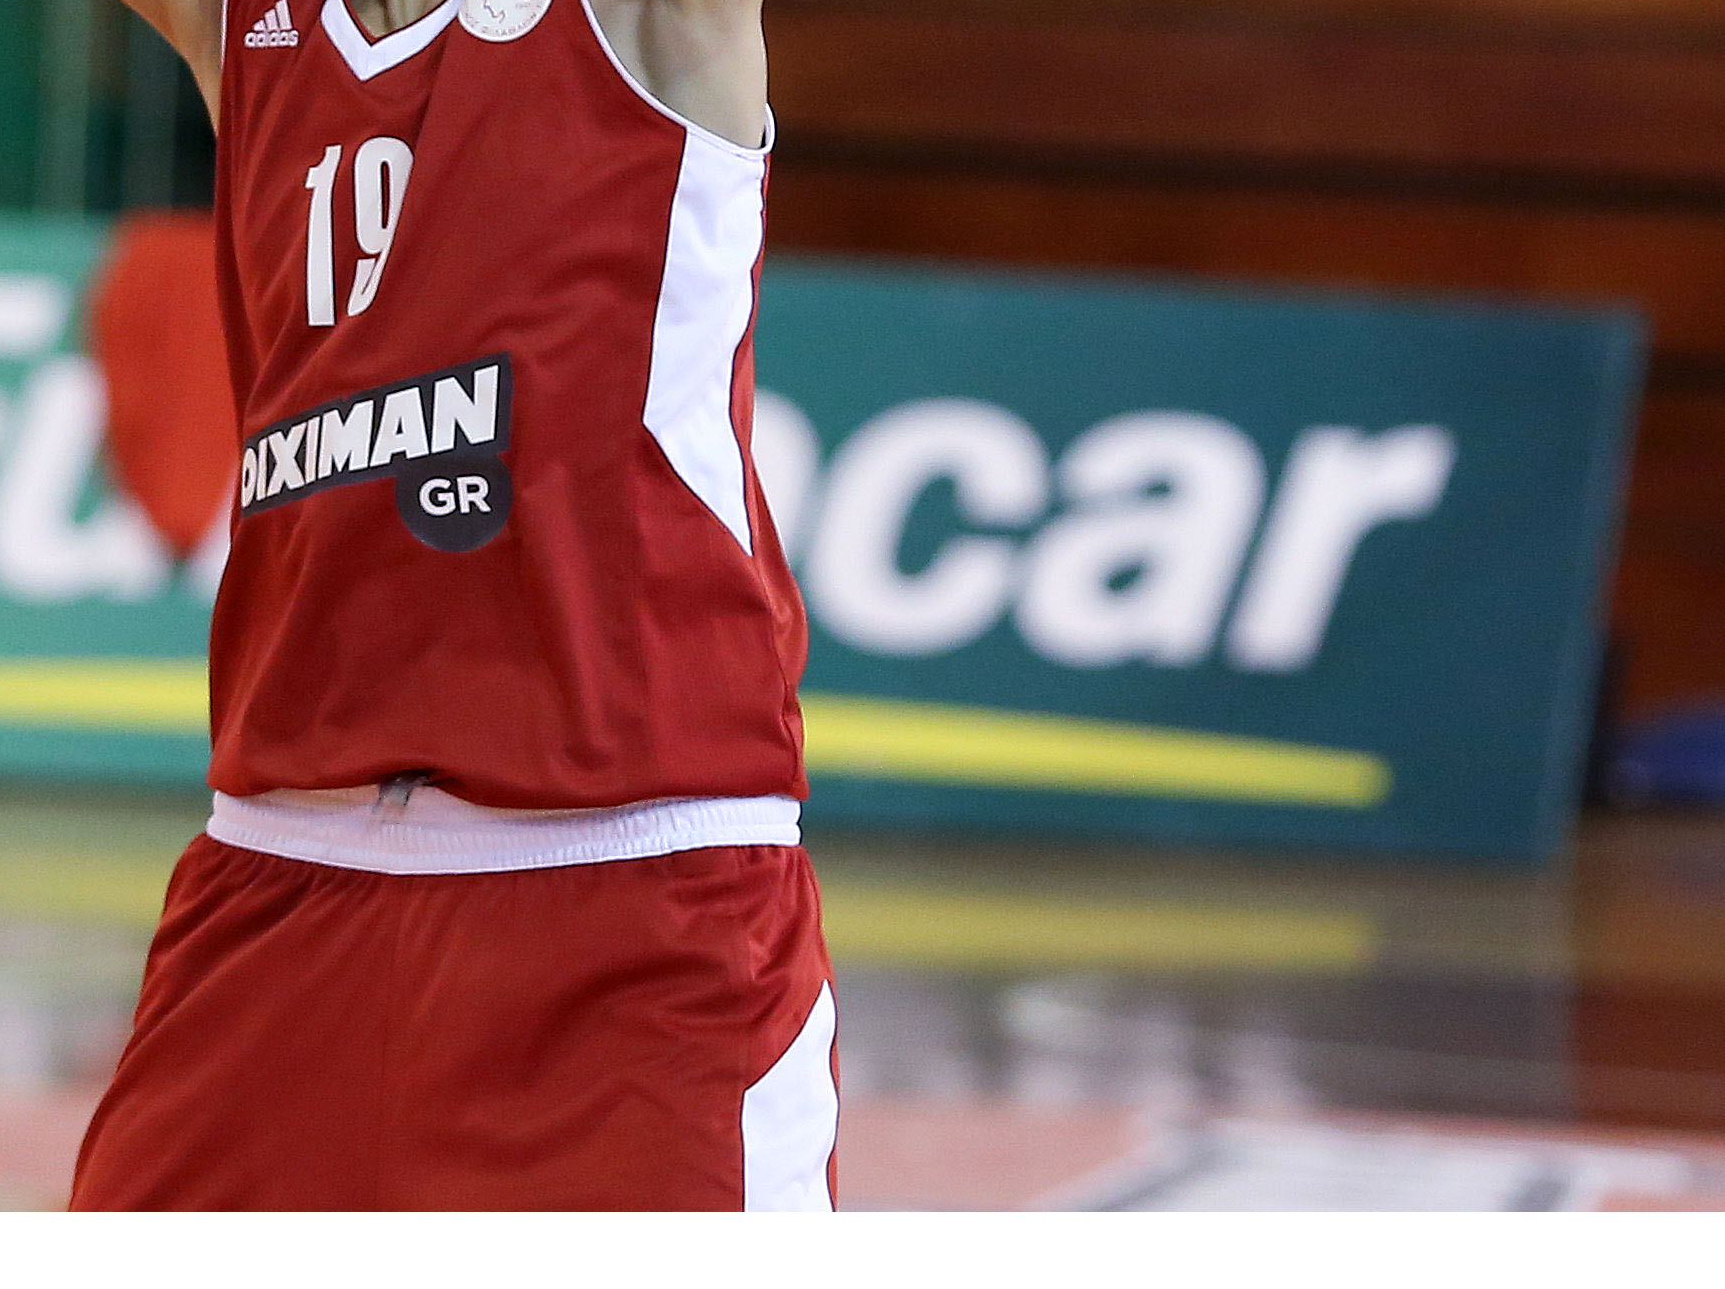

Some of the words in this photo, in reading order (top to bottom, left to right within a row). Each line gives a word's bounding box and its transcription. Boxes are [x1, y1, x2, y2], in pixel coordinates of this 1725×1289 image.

[244, 30, 299, 48] adidas
[305, 137, 414, 326] 19
[241, 364, 499, 509] DIXIMAN
[419, 475, 492, 516] GR
